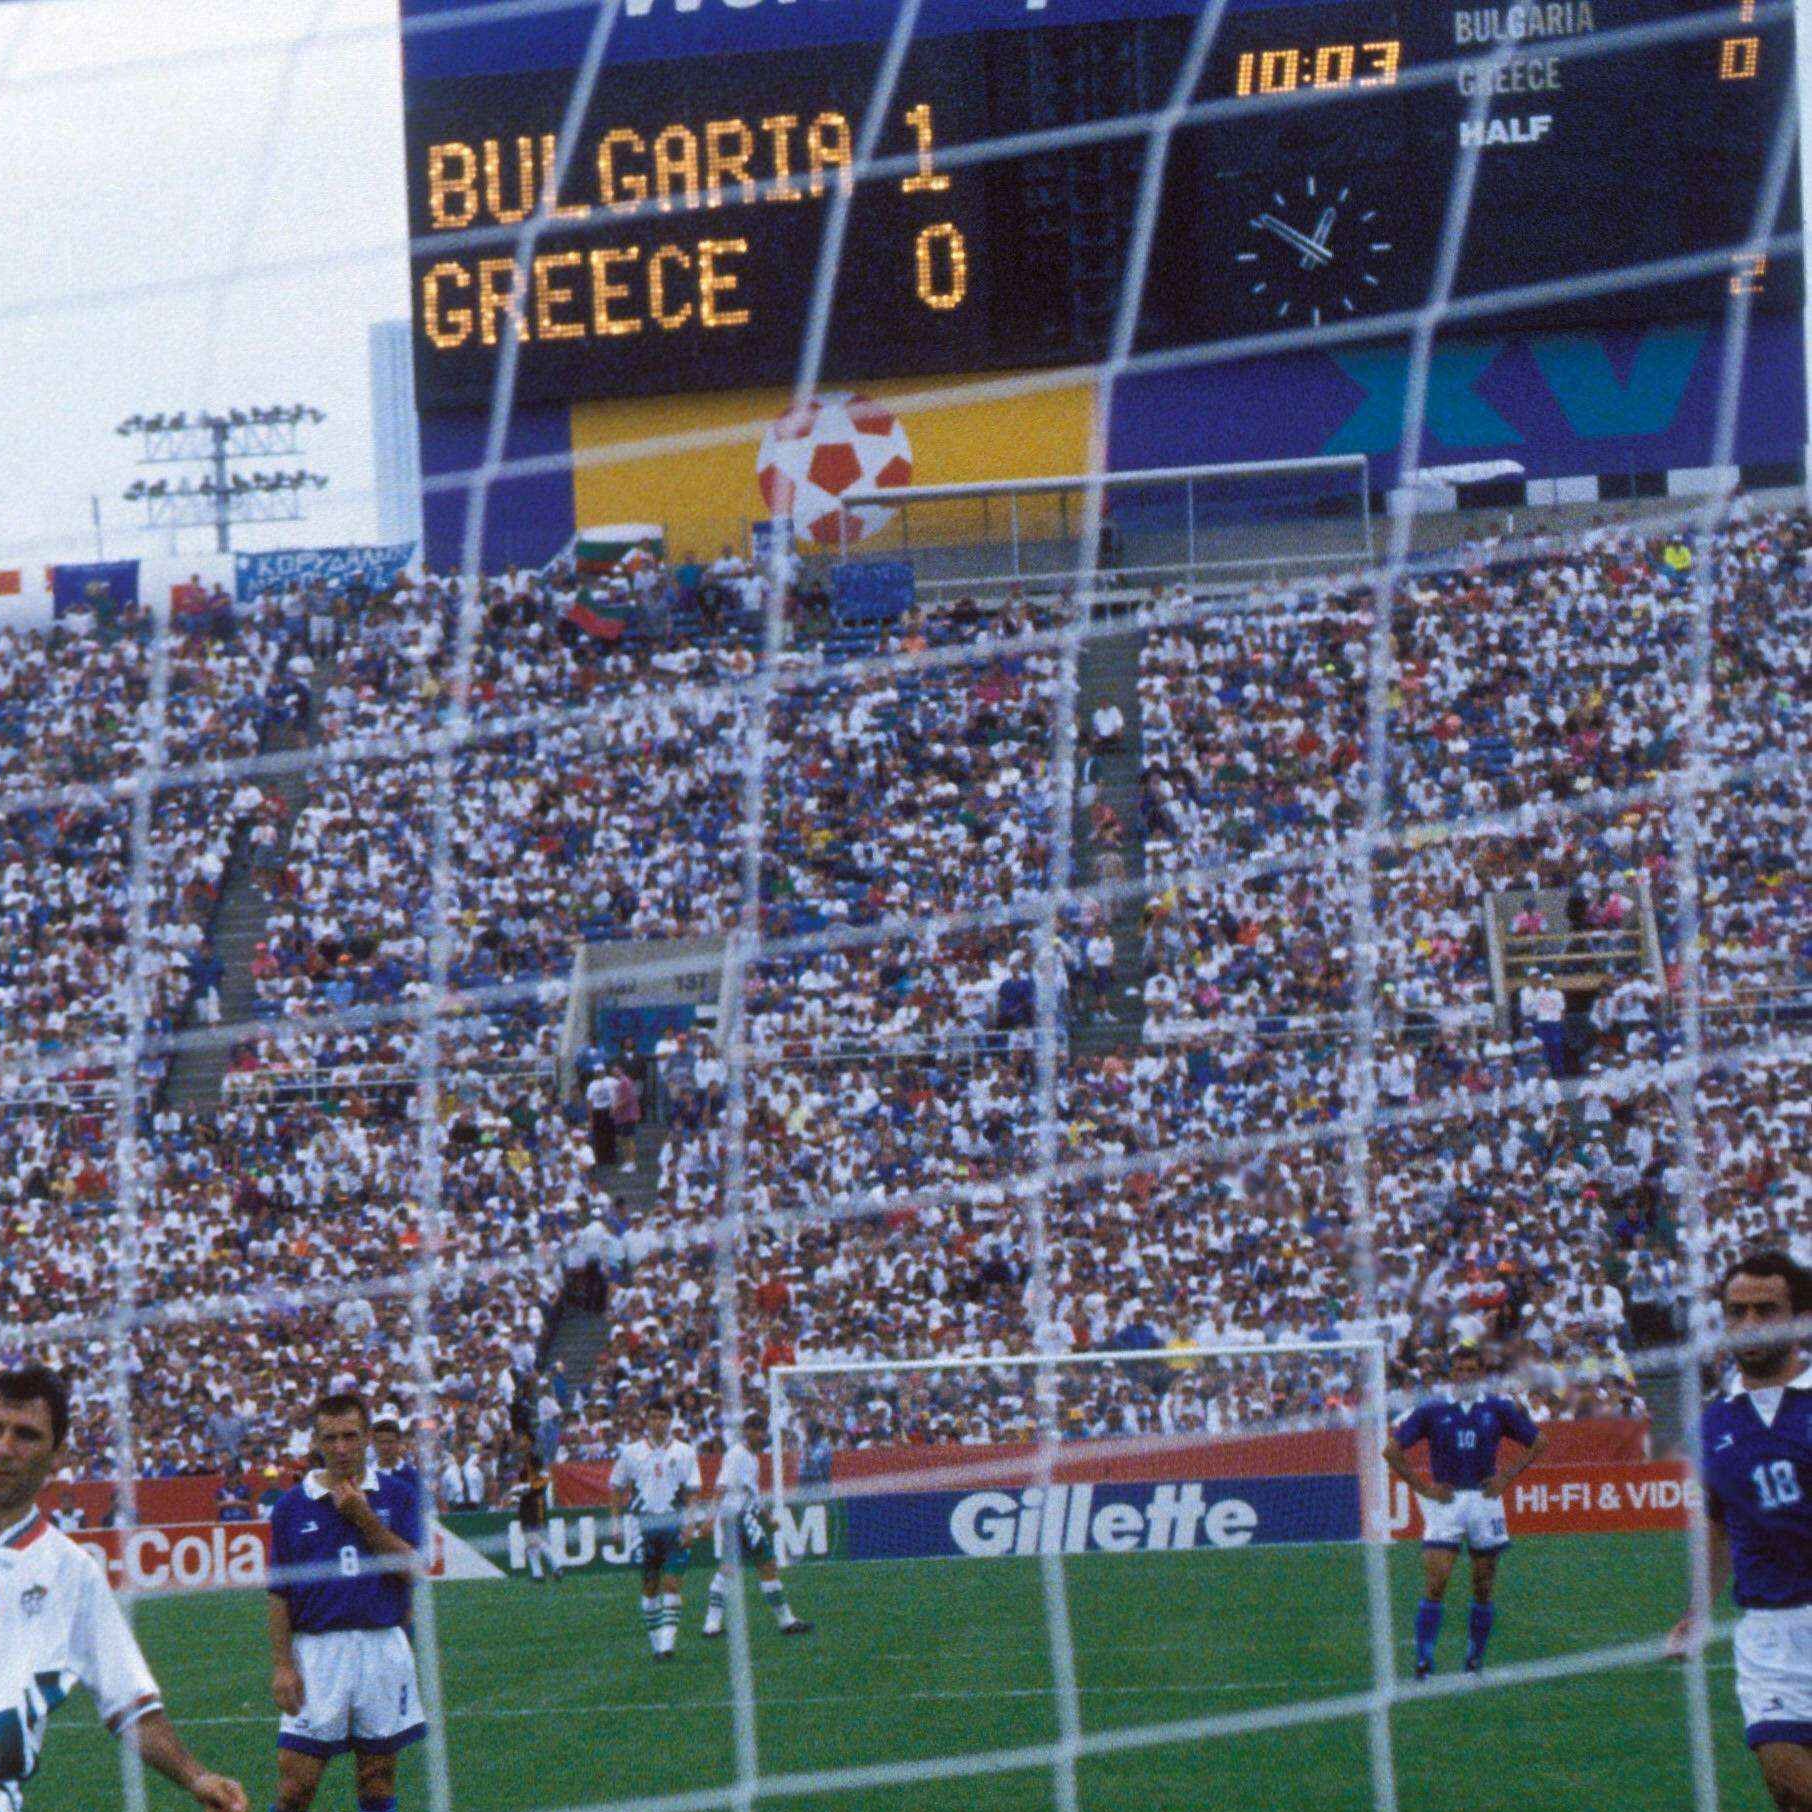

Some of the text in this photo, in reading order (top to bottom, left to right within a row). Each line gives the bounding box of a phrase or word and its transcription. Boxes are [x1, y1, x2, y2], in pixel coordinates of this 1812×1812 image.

[1455, 2, 1595, 43] BULGARIA
[1236, 40, 1400, 96] 10:03
[1459, 114, 1552, 148] HALF
[428, 103, 950, 228] BULGARIA 1
[422, 222, 966, 348] GREECE 0
[949, 1483, 1258, 1557] Gillette
[339, 1545, 359, 1577] 8
